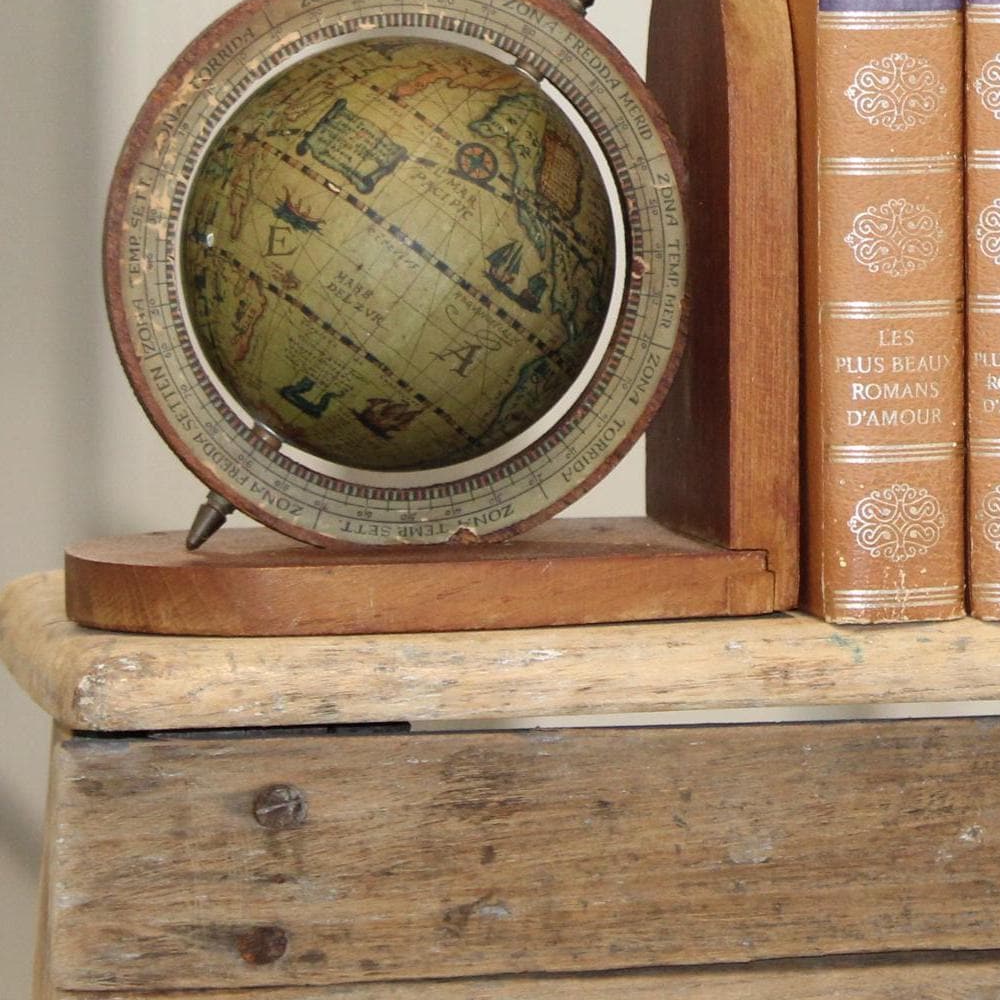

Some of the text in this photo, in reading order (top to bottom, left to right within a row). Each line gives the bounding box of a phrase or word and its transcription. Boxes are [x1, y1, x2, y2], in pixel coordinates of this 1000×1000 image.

[562, 31, 622, 90] FREDDA
[617, 91, 654, 141] MERID
[659, 293, 676, 329] MER
[879, 329, 915, 346] LES
[834, 354, 953, 374] PLUS BEAUX
[851, 382, 940, 401] ROMANS
[559, 352, 661, 482] ZONA TORRIDA
[846, 408, 942, 427] D'AMOUR
[191, 432, 249, 486] FREDDA
[248, 481, 304, 517] ZONA
